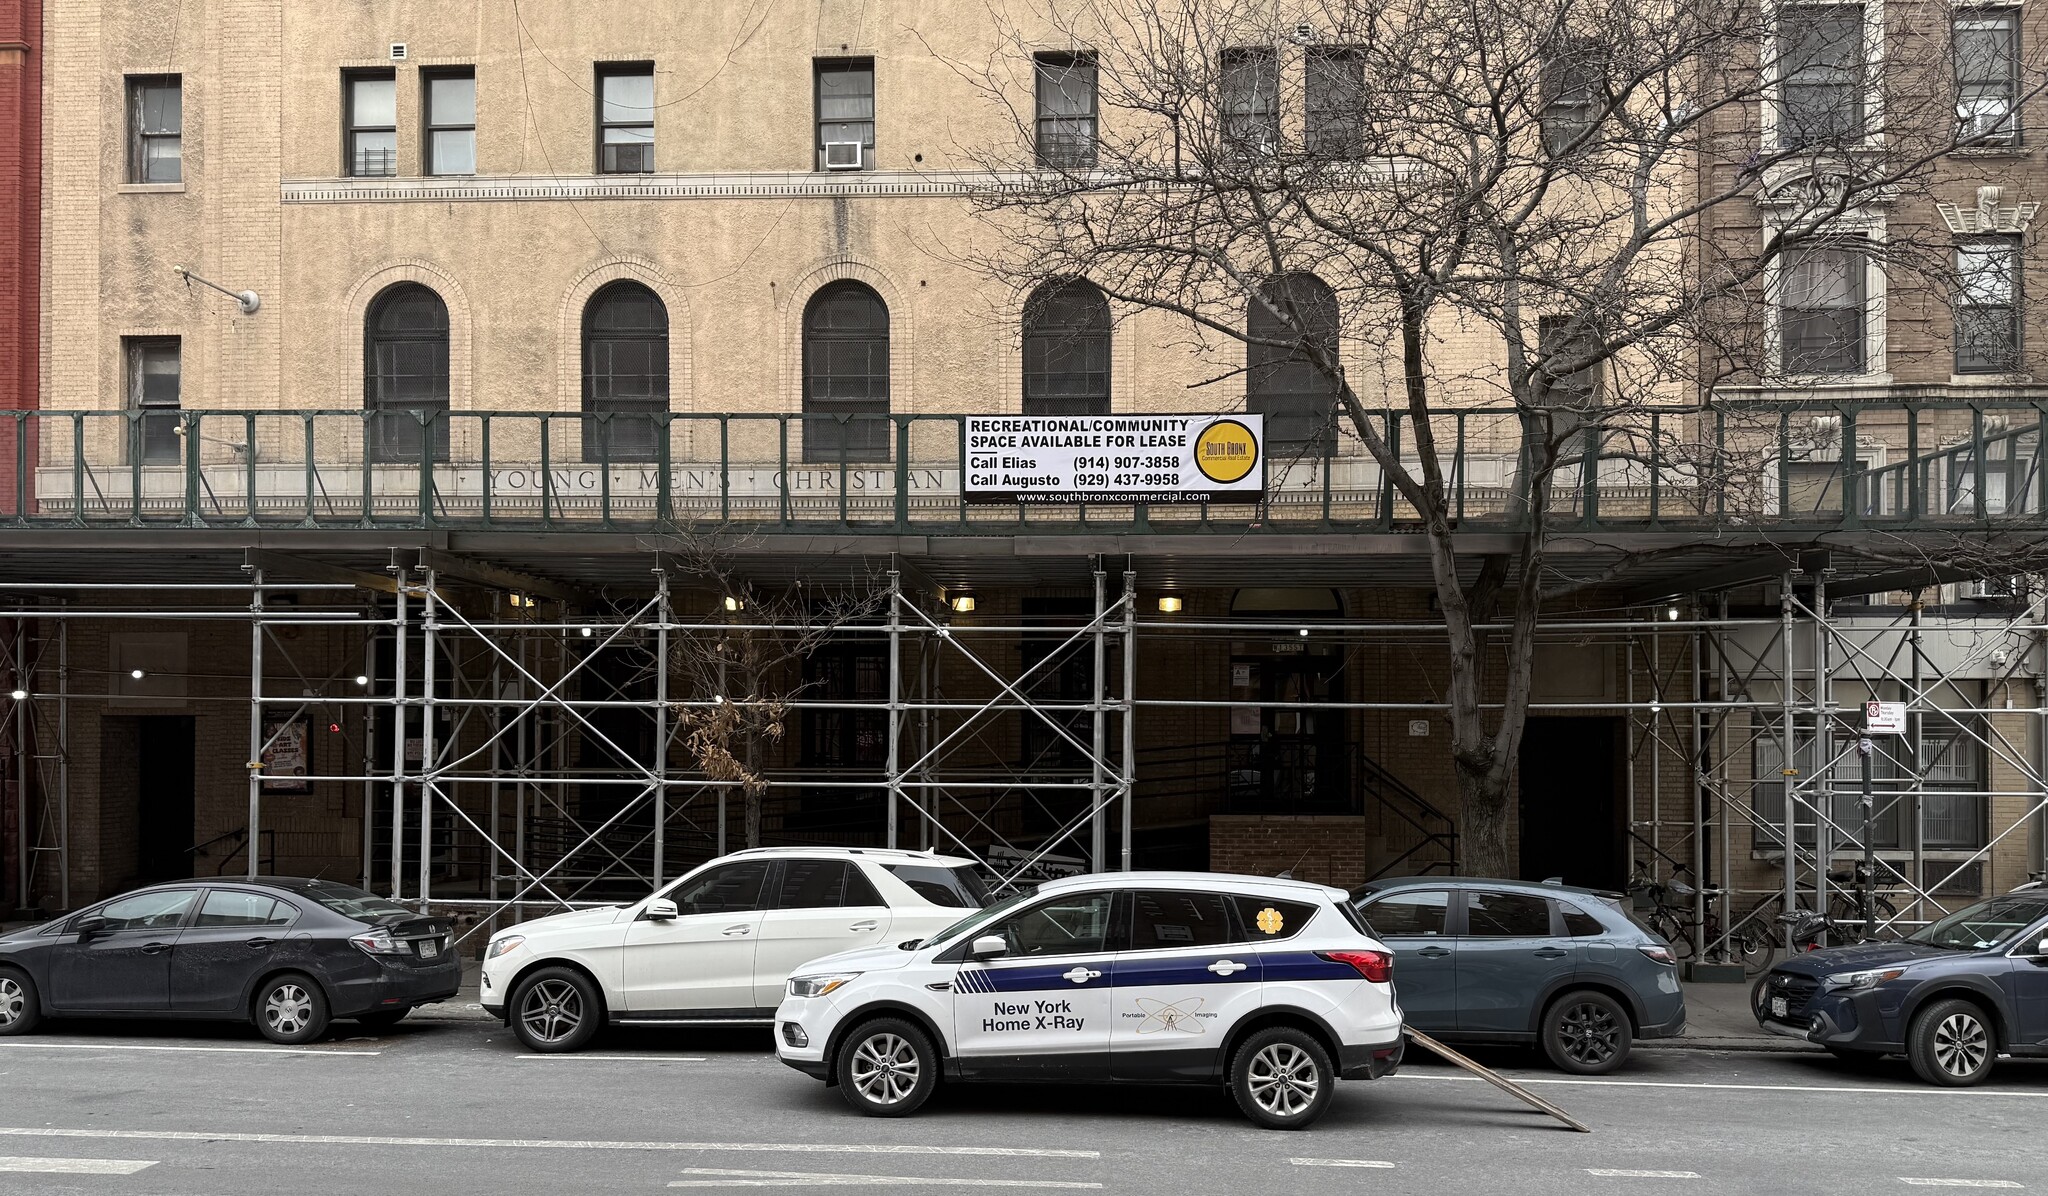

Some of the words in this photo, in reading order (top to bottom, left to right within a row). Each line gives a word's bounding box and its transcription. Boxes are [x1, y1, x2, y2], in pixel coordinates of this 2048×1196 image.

[970, 420, 1189, 432] RECREATIONAL/COMMUNITY
[970, 435, 1017, 448] SPACE
[1020, 435, 1101, 448] AVAILABLE
[1106, 435, 1135, 448] FOR
[1139, 435, 1186, 447] LEASE
[1206, 441, 1225, 456] SOUTH
[1226, 441, 1247, 456] BRONX
[970, 457, 998, 469] Call
[1002, 457, 1037, 469] Elias
[1073, 456, 1109, 472] (914)
[1114, 456, 1180, 469] 907-3858
[488, 470, 597, 489] YOUNG
[772, 470, 944, 489] CHRSTIAN
[970, 474, 998, 486] Call
[1001, 474, 1060, 488] Augusto
[1073, 473, 1109, 489] (929)
[1113, 473, 1180, 486] 437-9958
[1016, 490, 1210, 502] www.southbronxcommercial.com
[994, 1002, 1030, 1015] New
[1034, 999, 1071, 1014] York
[982, 1018, 1031, 1032] Home
[1035, 1015, 1085, 1031] X-Ray
